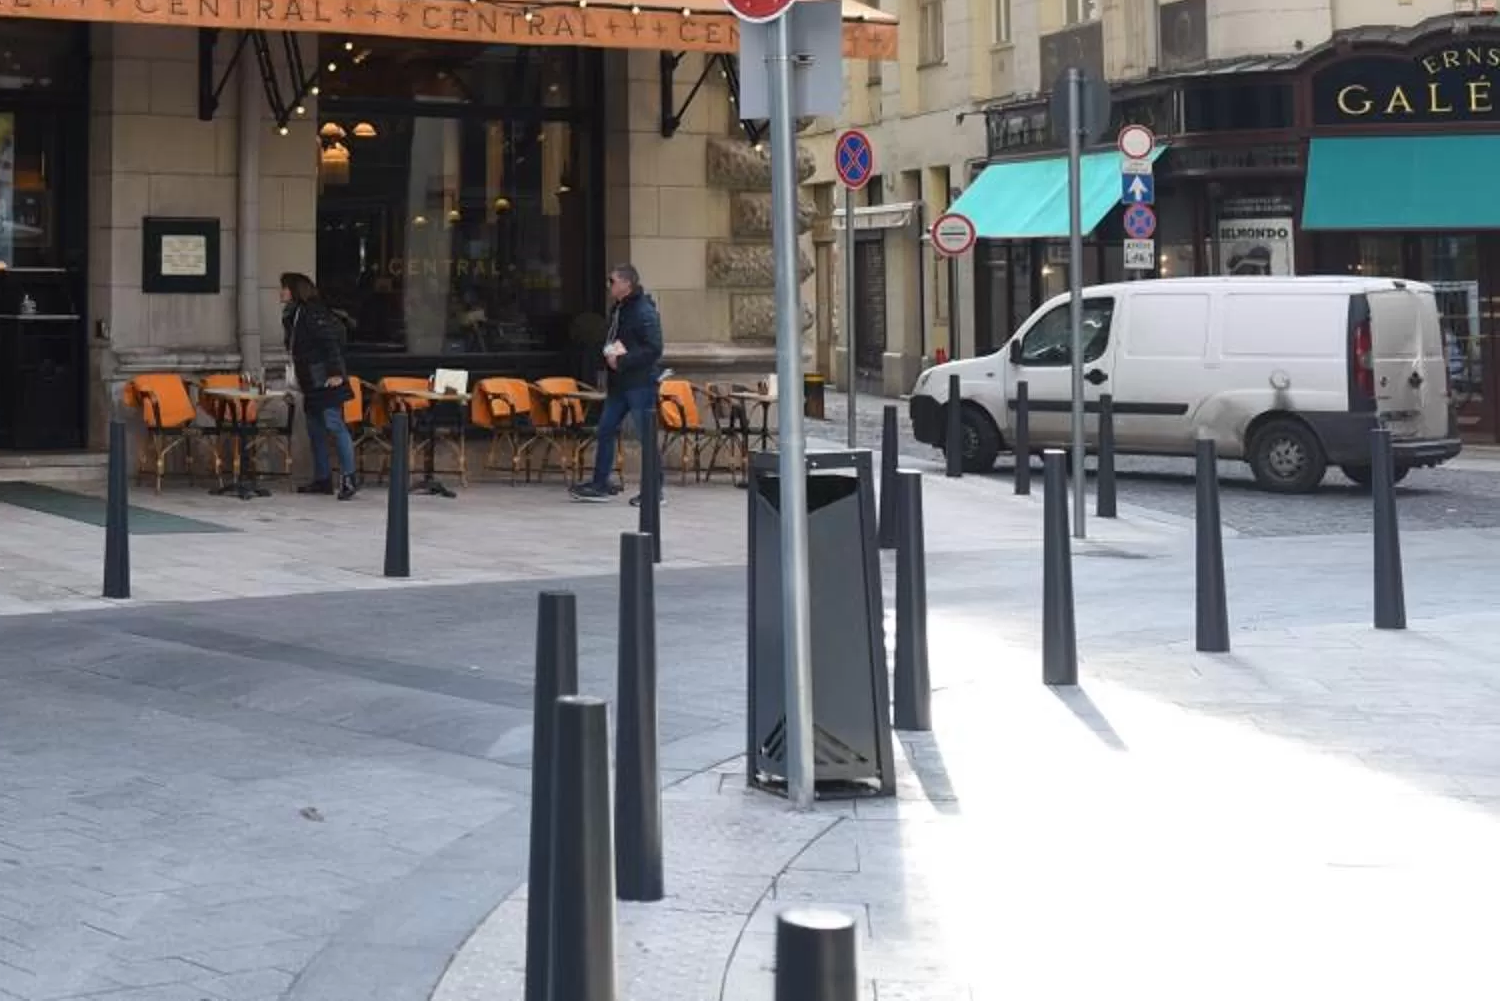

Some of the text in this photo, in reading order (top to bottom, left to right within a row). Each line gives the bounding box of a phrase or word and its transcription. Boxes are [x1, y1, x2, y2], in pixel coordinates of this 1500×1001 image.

[422, 5, 597, 39] CENTRAL
[1337, 74, 1493, 115] GALÉ
[388, 258, 502, 276] CENTRAL
